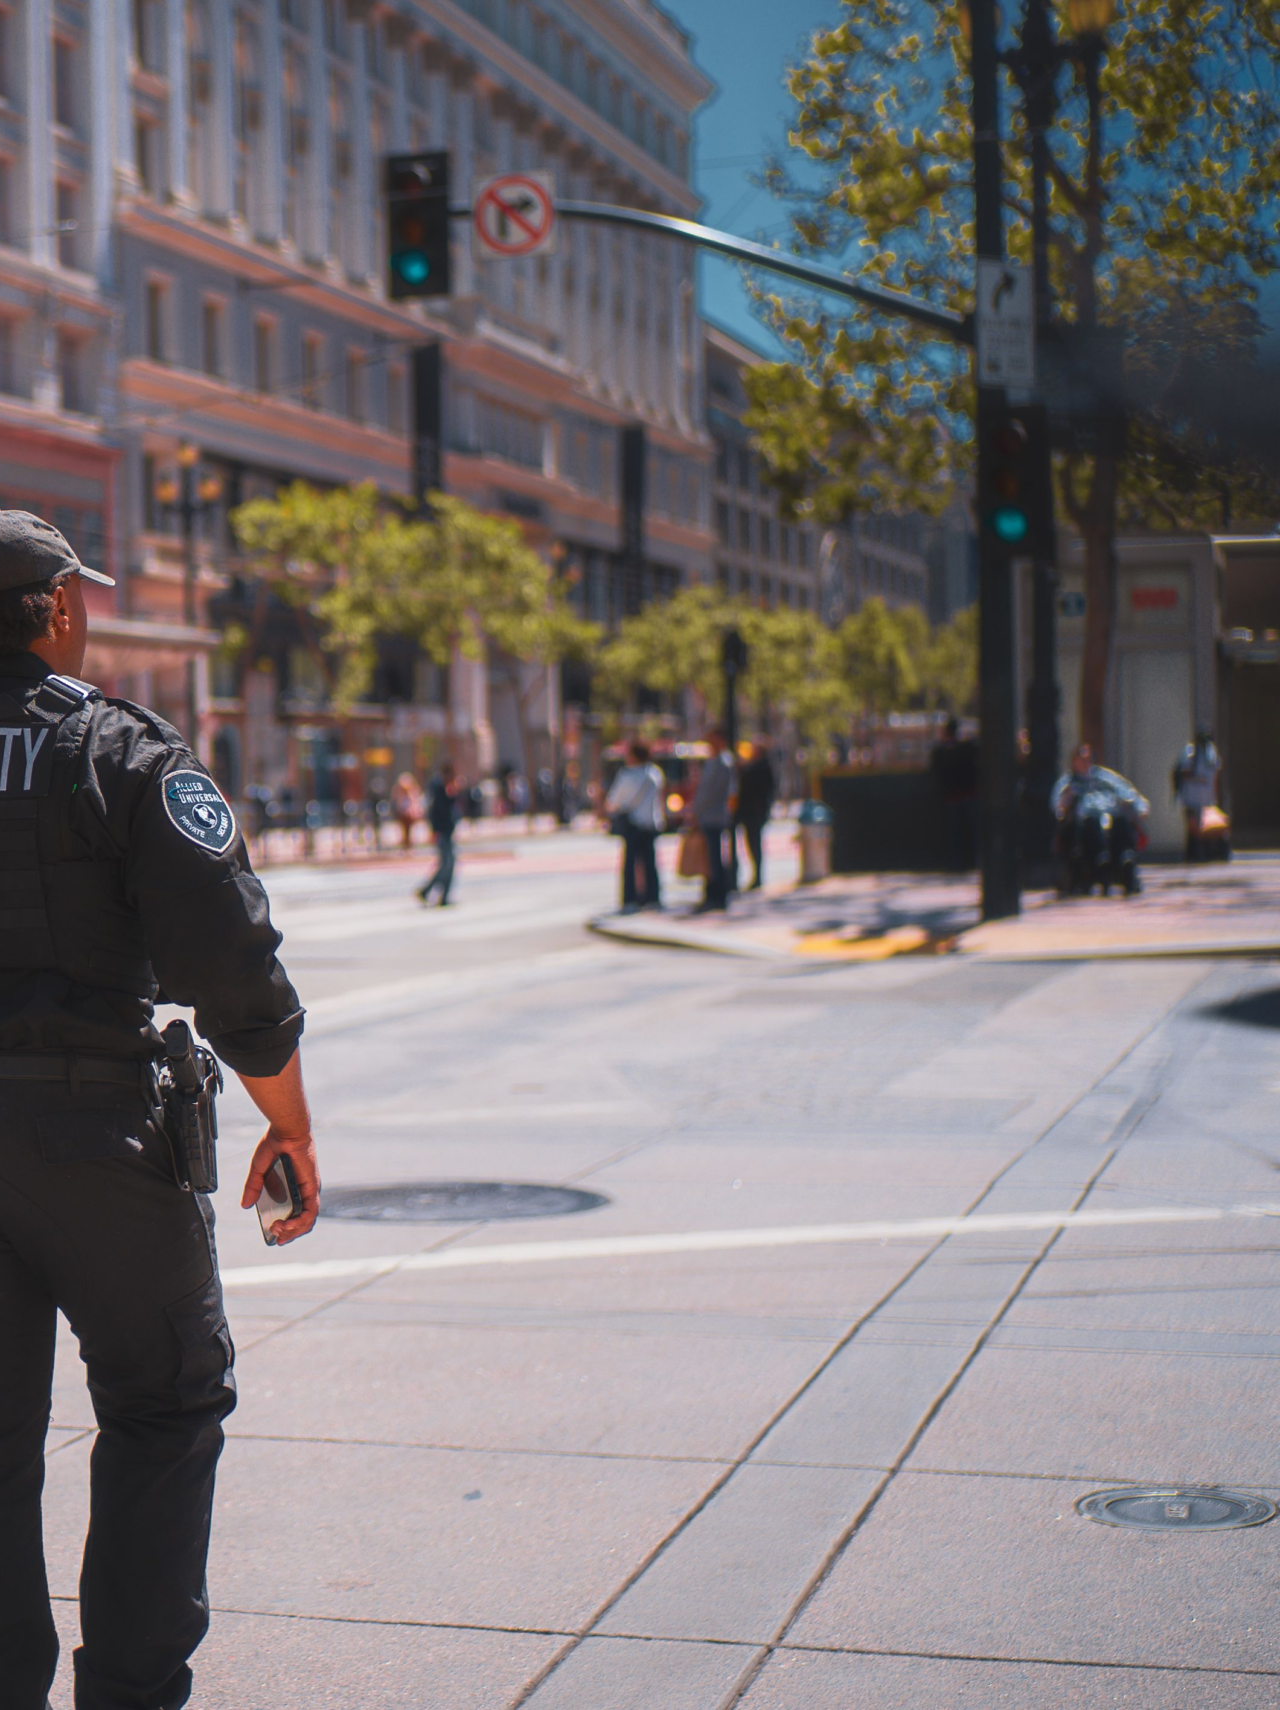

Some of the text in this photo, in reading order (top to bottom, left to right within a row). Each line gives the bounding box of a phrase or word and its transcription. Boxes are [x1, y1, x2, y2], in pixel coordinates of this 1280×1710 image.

[175, 781, 204, 793] ALLIED
[179, 793, 223, 804] UNIVERSAL
[179, 811, 228, 838] PRIVATE SECURITY
